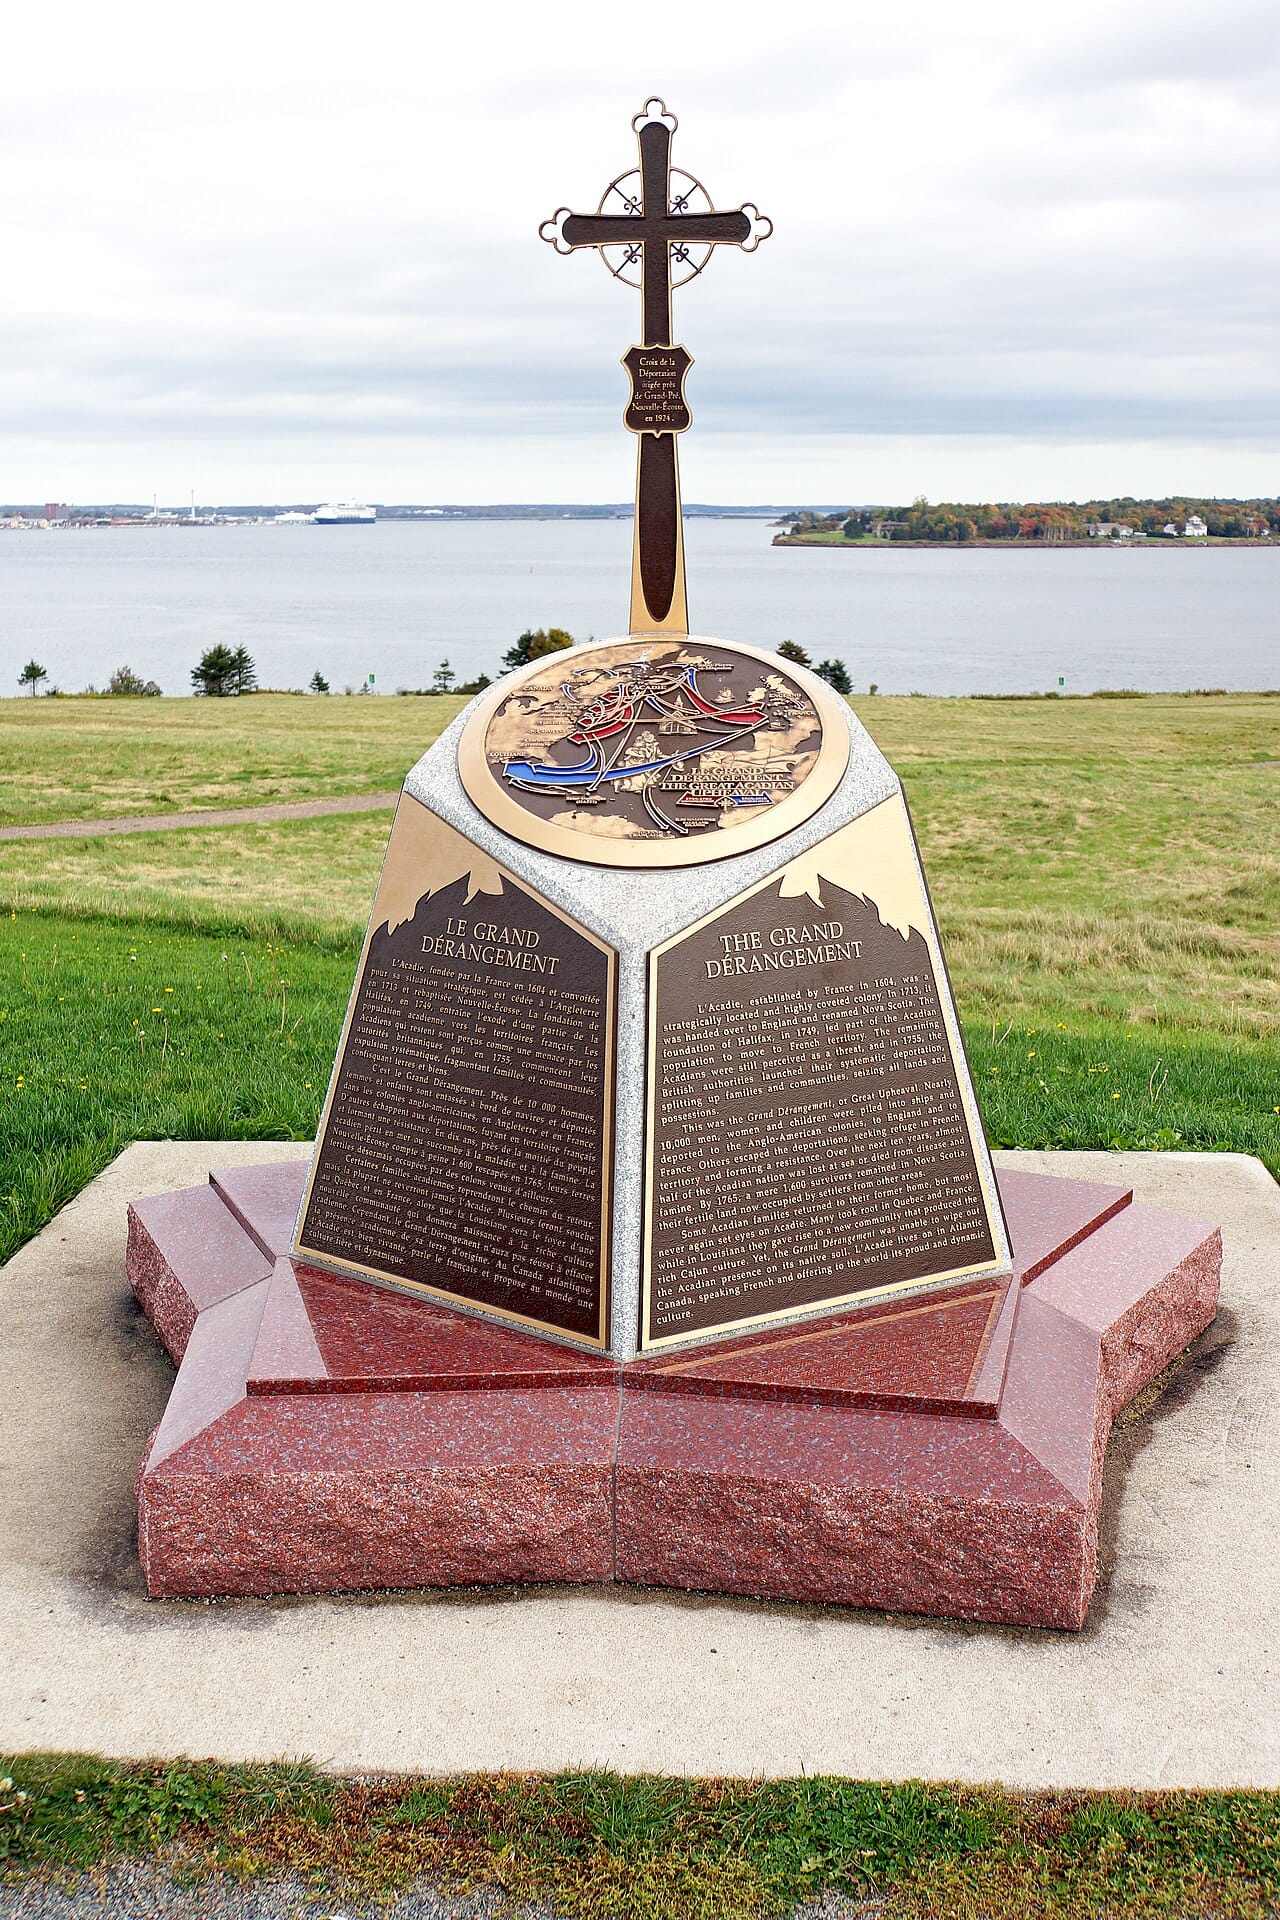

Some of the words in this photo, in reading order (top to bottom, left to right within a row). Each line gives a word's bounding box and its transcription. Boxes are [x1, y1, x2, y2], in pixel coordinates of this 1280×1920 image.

[638, 368, 677, 379] Déportation
[639, 357, 658, 366] Croix
[660, 358, 667, 366] de
[669, 358, 676, 366] la
[631, 401, 684, 411] Nouvelle-Écosse
[634, 392, 643, 400] de
[659, 782, 689, 790] THE
[689, 782, 736, 790] GREAT
[736, 782, 795, 790] ACADIAN
[690, 767, 710, 775] LE
[712, 767, 765, 775] GRAND
[446, 917, 468, 937] LE
[473, 922, 540, 948] GRAND
[719, 931, 763, 953] THE
[769, 921, 844, 947] GRAND
[421, 934, 560, 975] DÉRANGEMENT
[705, 940, 863, 979] DÉRANGEMENT
[725, 1008, 759, 1022] located
[762, 1005, 780, 1016] and
[783, 1001, 813, 1015] highly
[815, 995, 850, 1008] coveted
[886, 988, 897, 998] In
[923, 983, 932, 992] it
[806, 988, 819, 999] by
[823, 984, 854, 995] France
[858, 981, 869, 990] in
[901, 975, 919, 983] was
[662, 1035, 681, 1044] was
[684, 1027, 719, 1041] handed
[722, 1026, 744, 1035] over
[747, 1023, 758, 1031] to
[760, 1015, 798, 1030] England
[801, 1012, 818, 1023] and
[821, 1006, 859, 1020] renamed
[861, 1004, 885, 1014] Nova
[918, 995, 935, 1005] The
[720, 1038, 731, 1048] of
[780, 1031, 791, 1039] in
[824, 1022, 839, 1032] led
[844, 1018, 864, 1032] part
[868, 1015, 878, 1025] of
[882, 1013, 898, 1023] the
[901, 1008, 937, 1020] Acadian
[721, 1052, 733, 1061] to
[739, 1048, 765, 1058] move
[771, 1045, 782, 1053] to
[789, 1037, 820, 1050] French
[873, 1027, 890, 1037] The
[896, 1020, 940, 1033] remaining
[662, 1071, 706, 1084] Acadians
[710, 1066, 734, 1076] were
[737, 1060, 757, 1071] still
[761, 1052, 806, 1070] perceived
[868, 1039, 885, 1050] and
[888, 1038, 899, 1047] in
[927, 1031, 942, 1040] the
[681, 1122, 703, 1133] This
[706, 1119, 725, 1129] was
[727, 1115, 743, 1125] the
[746, 1108, 774, 1122] Grand
[850, 1091, 875, 1103] Great
[922, 1078, 952, 1090] Nearly
